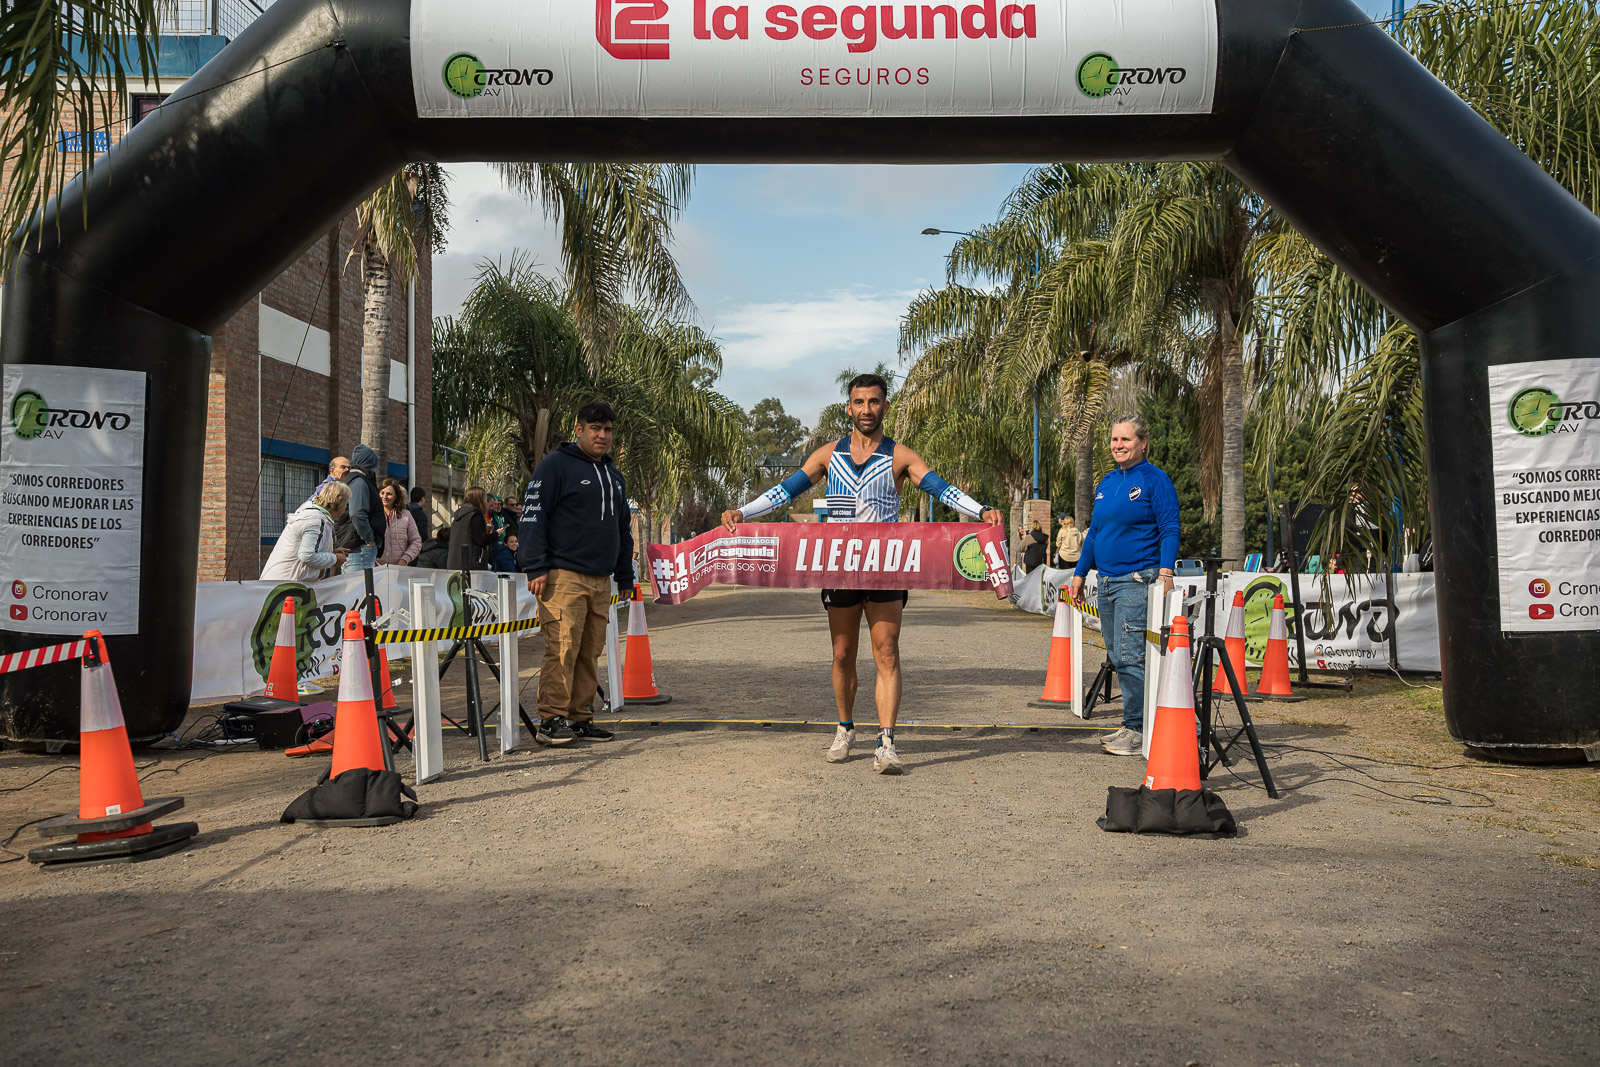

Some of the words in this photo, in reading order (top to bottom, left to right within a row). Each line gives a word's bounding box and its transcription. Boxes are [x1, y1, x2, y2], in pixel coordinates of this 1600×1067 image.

[693, 0, 749, 40] la
[764, 0, 1037, 53] segunda
[473, 68, 554, 87] CRONO
[800, 66, 931, 86] SEGUROS
[1106, 67, 1187, 85] CRONO
[473, 88, 501, 97] RAV
[1104, 86, 1132, 96] RAV
[35, 408, 131, 430] CRONO
[33, 428, 64, 440] RAV
[1545, 422, 1579, 434] RAV
[46, 476, 124, 491] CORREDORES
[2, 491, 49, 507] BUSCANDO
[52, 496, 109, 510] MEJORAR
[112, 498, 134, 511] LAS
[1503, 490, 1570, 505] BUSCANDO
[8, 512, 78, 529] EXPERIENCIAS
[81, 517, 97, 529] DE
[100, 518, 122, 530] LOS
[1515, 508, 1600, 524] EXPERIENCIAS
[795, 538, 922, 573] LLEGADA
[652, 552, 688, 579] #1
[692, 572, 701, 583] LO
[700, 562, 735, 577] PRIMERO
[736, 562, 755, 572] SOS
[756, 563, 776, 572] VOS
[32, 585, 108, 601] Cronorav
[657, 577, 689, 594] VOS
[1558, 581, 1600, 596] Cron
[32, 606, 107, 621] Cronorav
